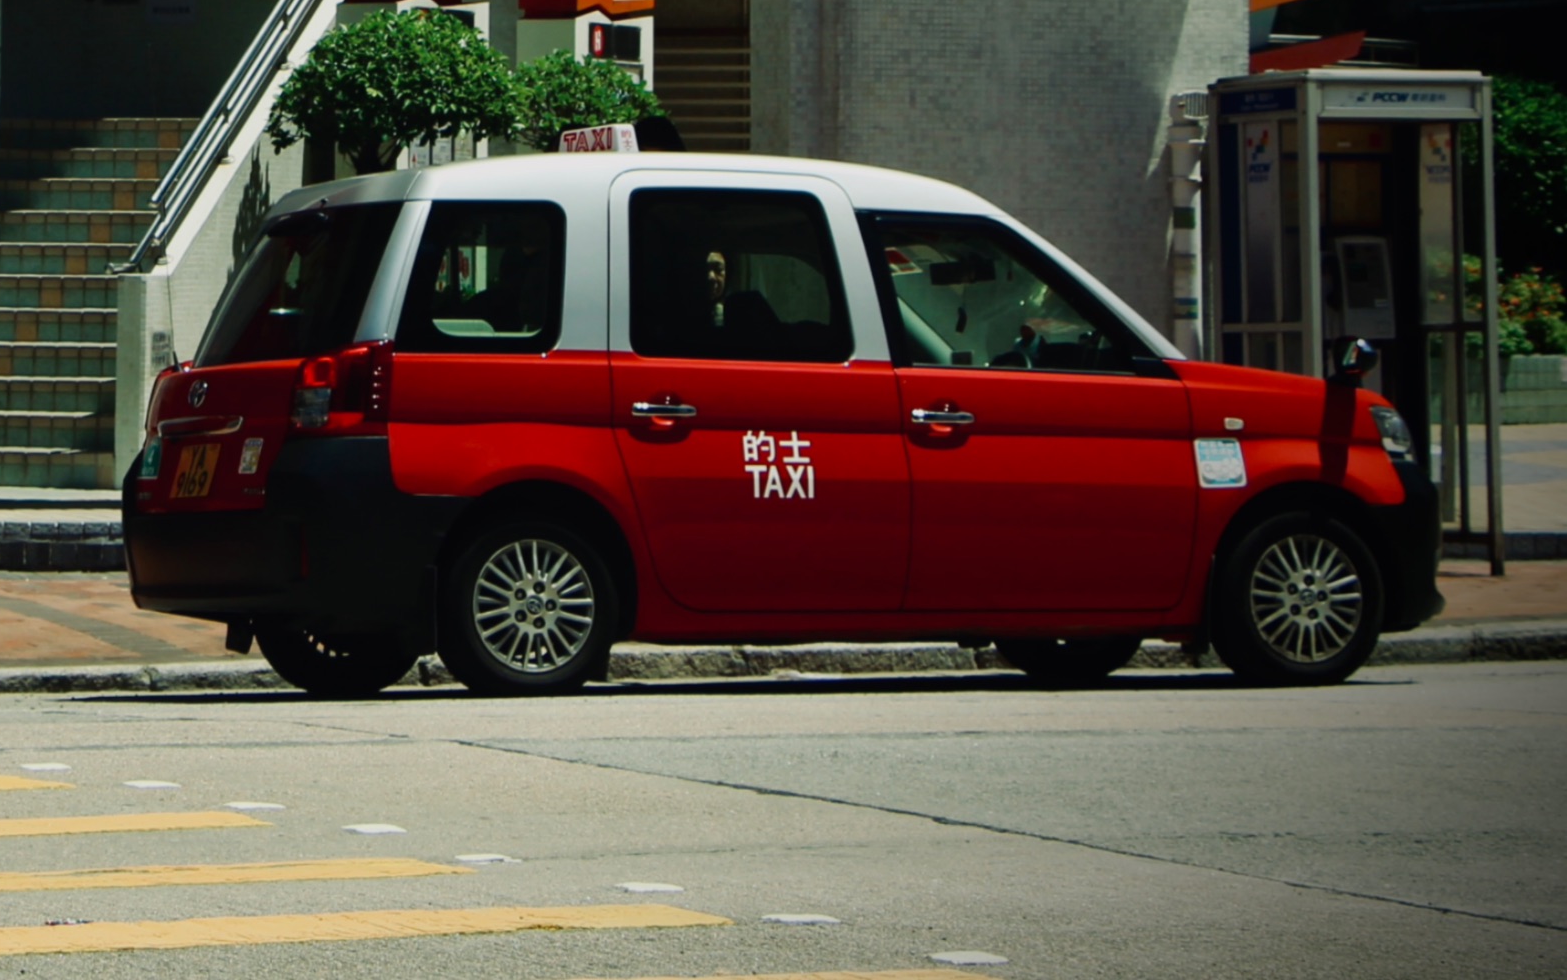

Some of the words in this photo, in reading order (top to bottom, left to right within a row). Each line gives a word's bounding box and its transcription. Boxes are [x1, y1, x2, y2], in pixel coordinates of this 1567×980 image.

[1372, 92, 1410, 102] PCCW
[563, 127, 613, 152] TAXI
[188, 444, 207, 471] YA
[741, 429, 812, 464] 的士
[176, 467, 208, 497] 9169
[744, 464, 816, 500] TAXI
